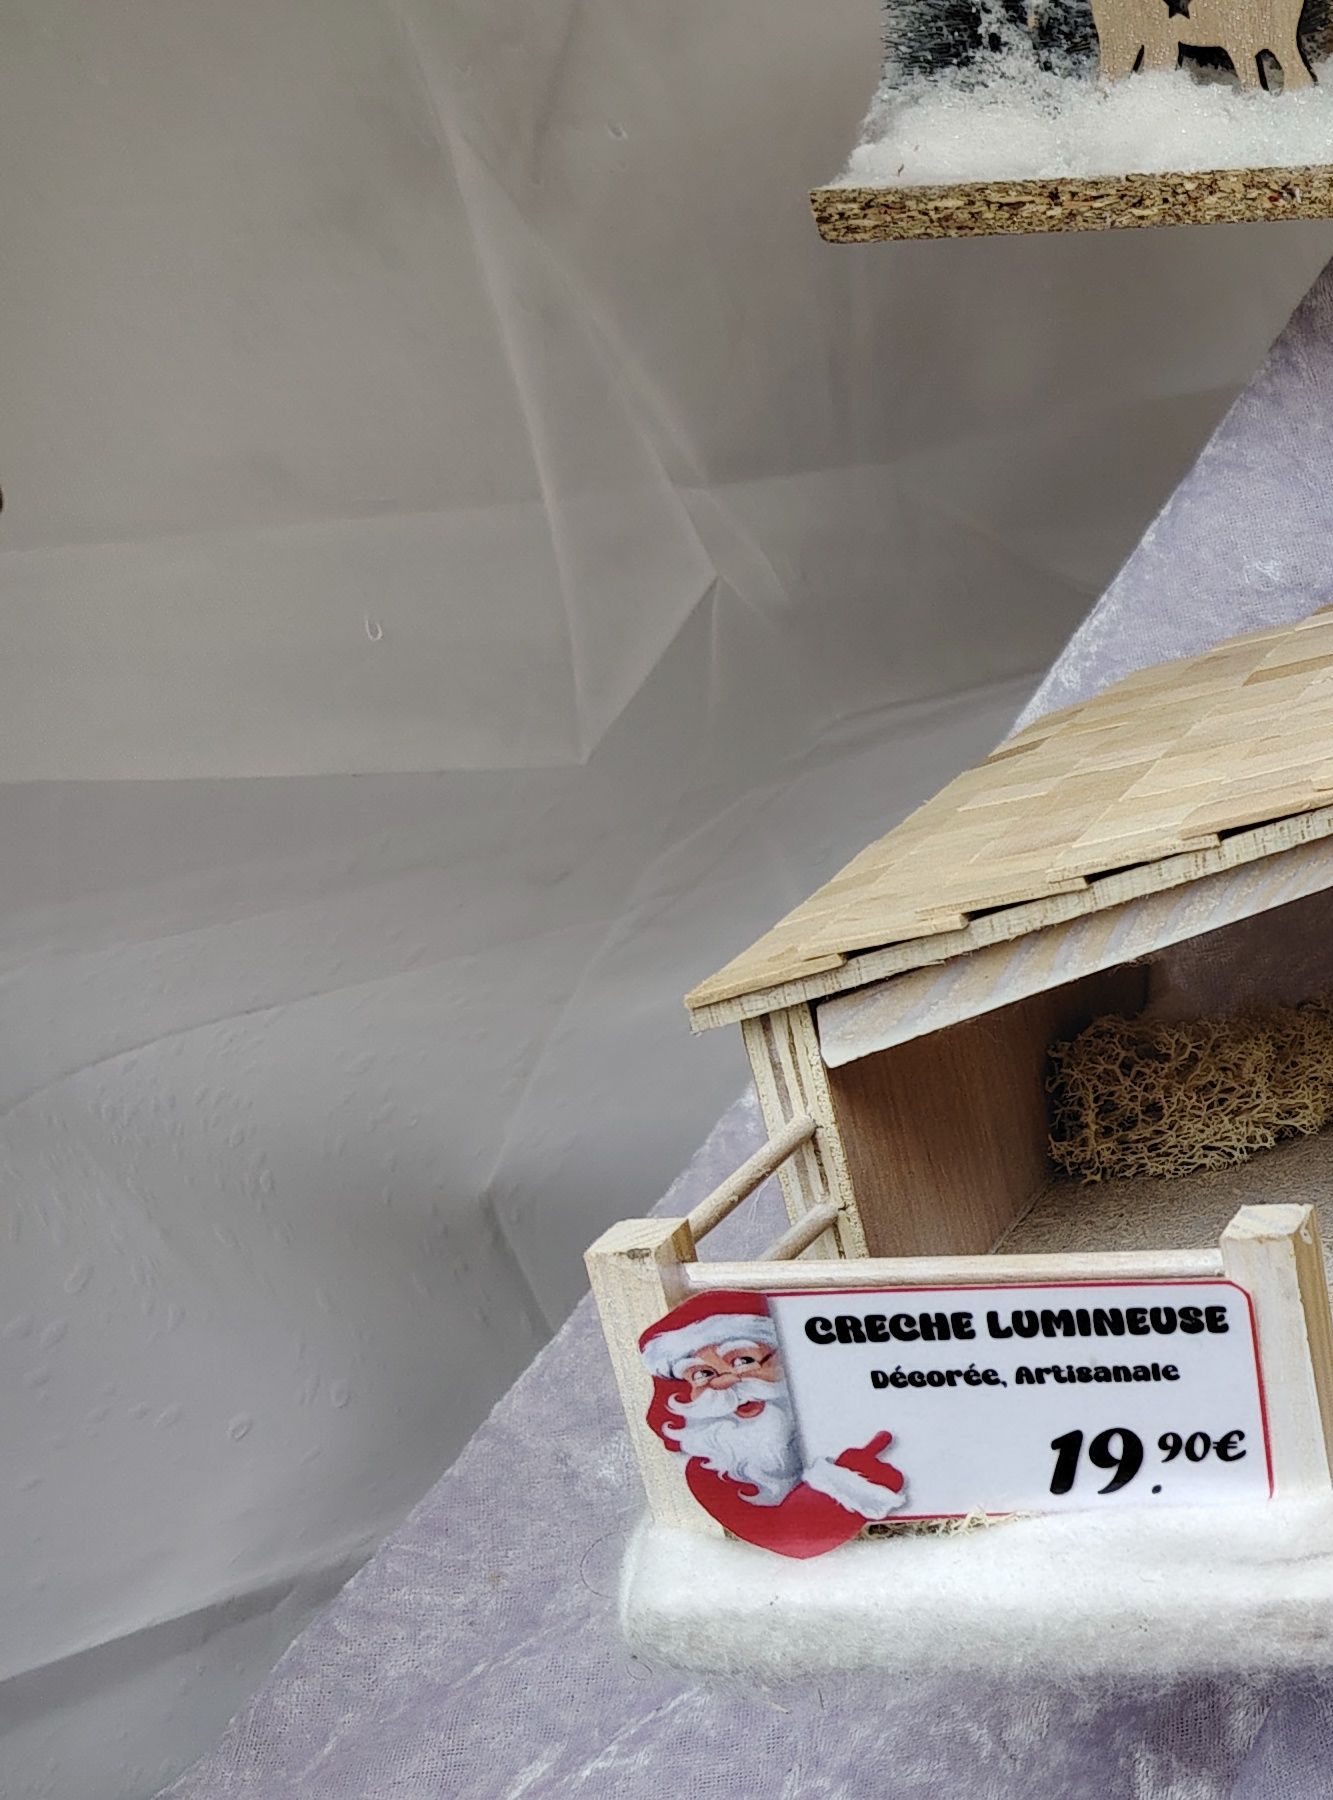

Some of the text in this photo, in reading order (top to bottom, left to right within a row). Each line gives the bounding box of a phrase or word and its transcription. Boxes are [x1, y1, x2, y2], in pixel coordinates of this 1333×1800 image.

[803, 1305, 1230, 1346] CRECHE LUMINEUSE
[869, 1361, 1181, 1390] Décorée, Artisanale
